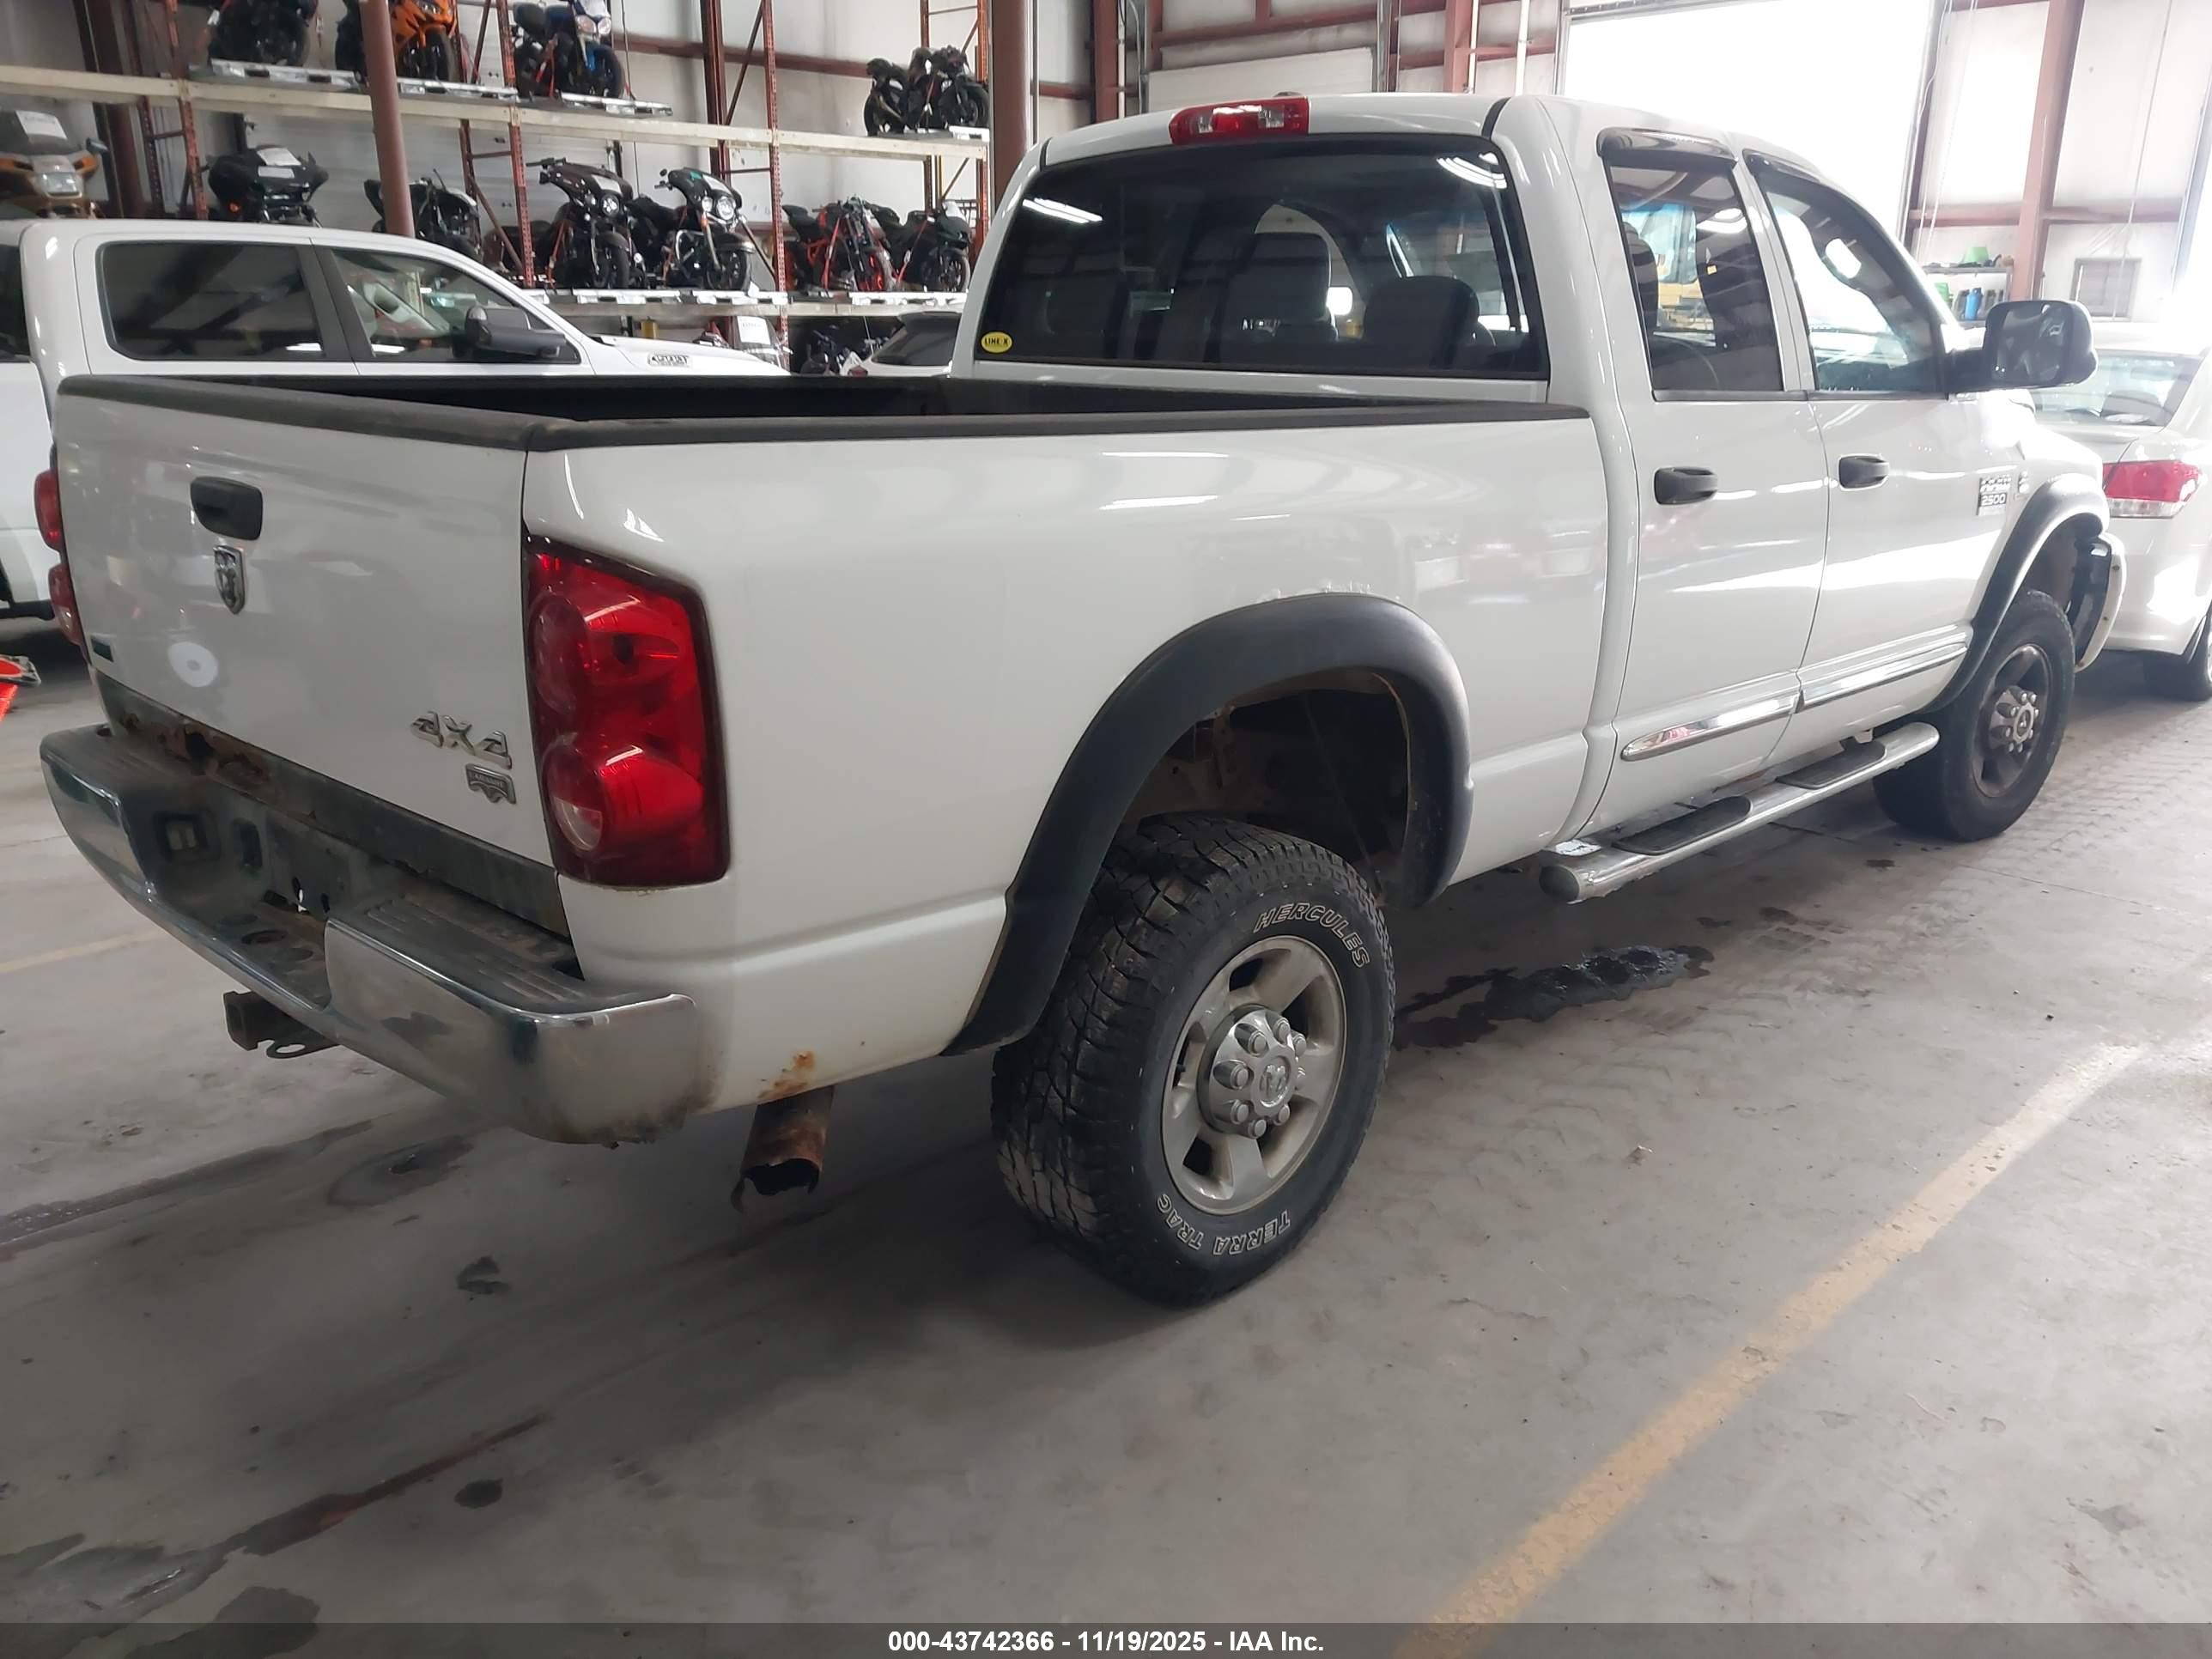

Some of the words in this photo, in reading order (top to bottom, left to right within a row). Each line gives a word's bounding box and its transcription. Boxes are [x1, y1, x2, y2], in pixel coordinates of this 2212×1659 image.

[1981, 493, 2007, 506] 2500
[1253, 902, 1370, 969] HERCULES
[1157, 1193, 1205, 1250] TRAC
[1212, 1209, 1291, 1255] TERRA
